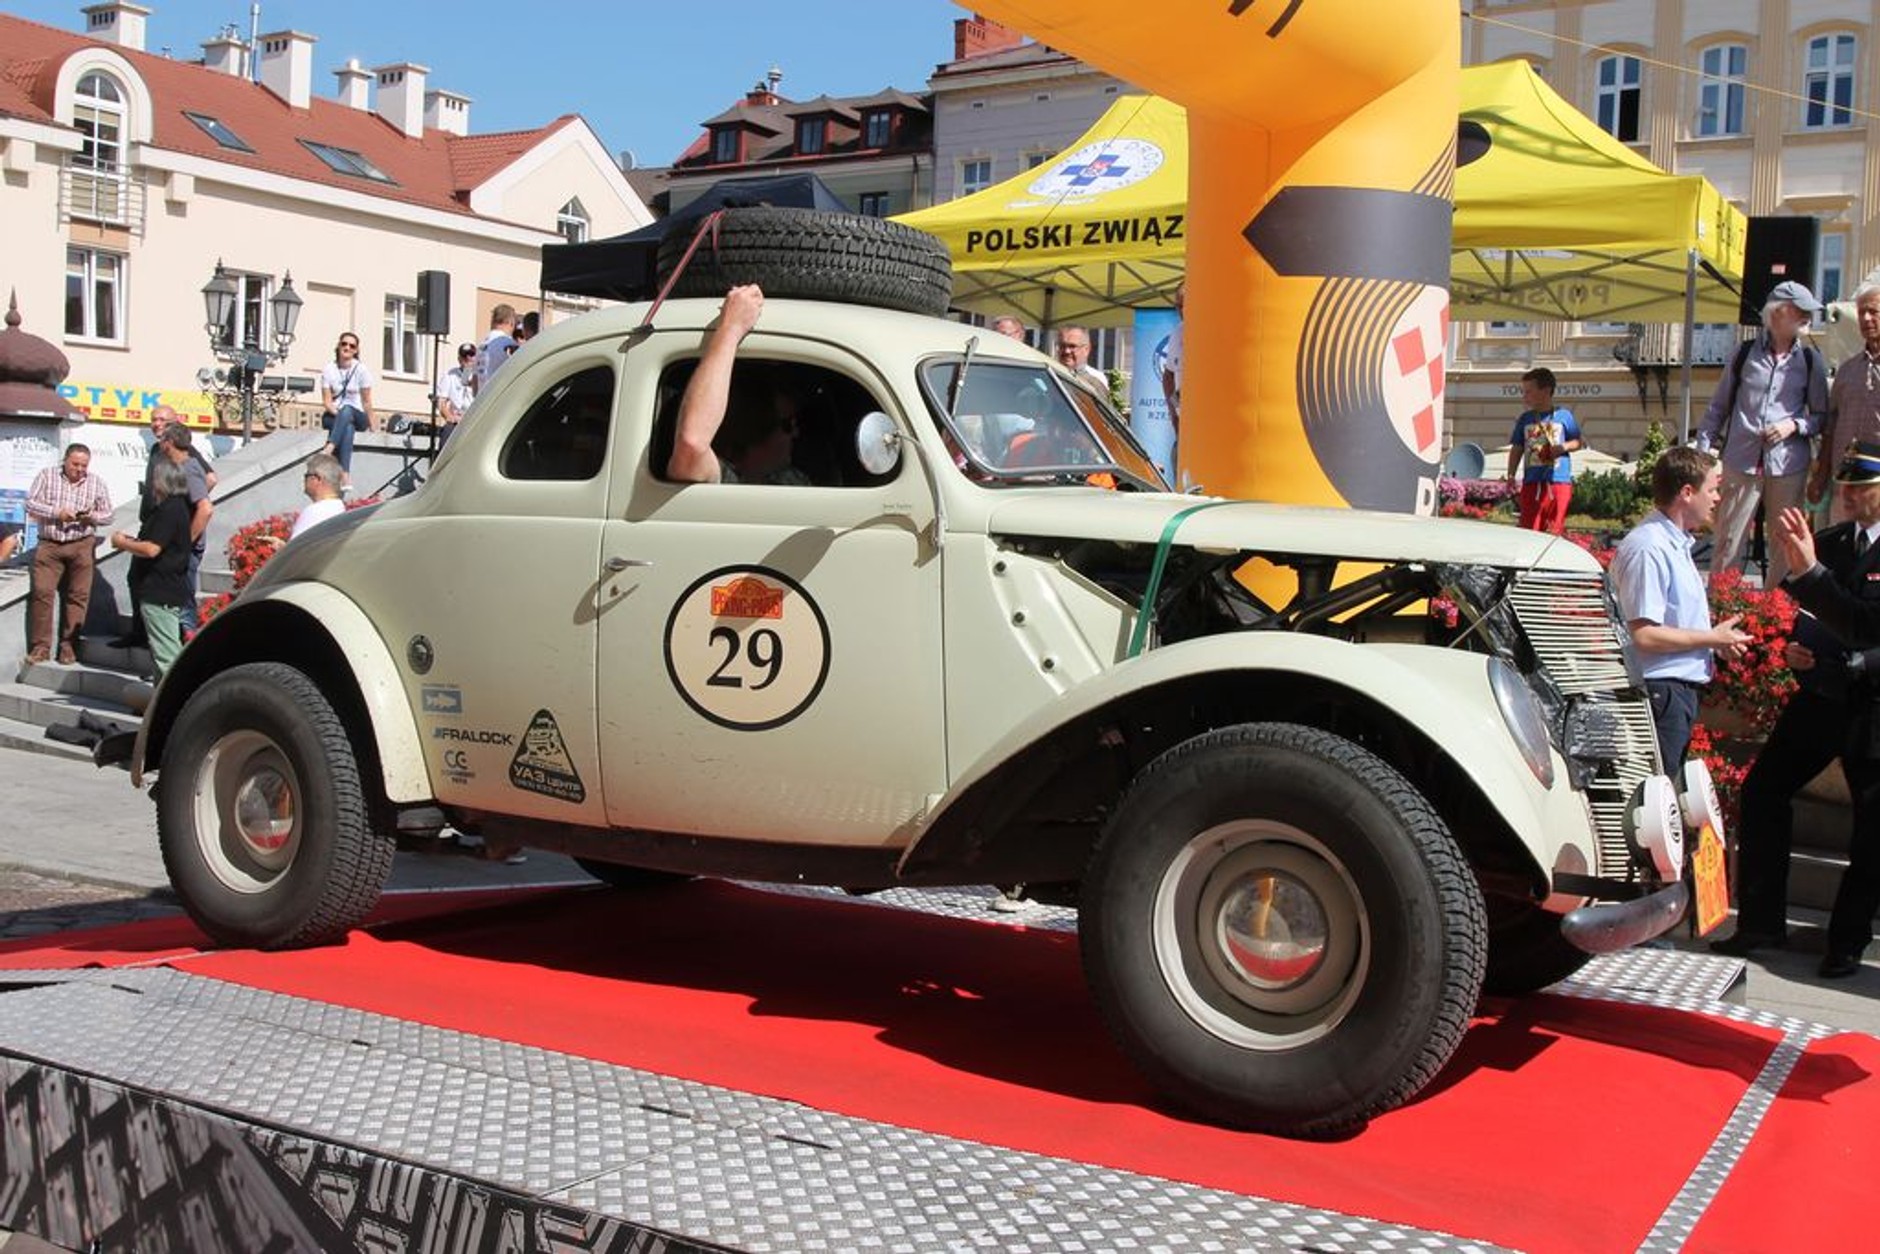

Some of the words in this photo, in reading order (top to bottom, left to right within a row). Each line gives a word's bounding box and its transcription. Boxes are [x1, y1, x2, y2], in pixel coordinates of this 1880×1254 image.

[966, 224, 1072, 252] POLSKI
[1082, 214, 1185, 247] ZWIĄZ
[706, 625, 783, 691] 29
[440, 727, 513, 746] FRALOCK
